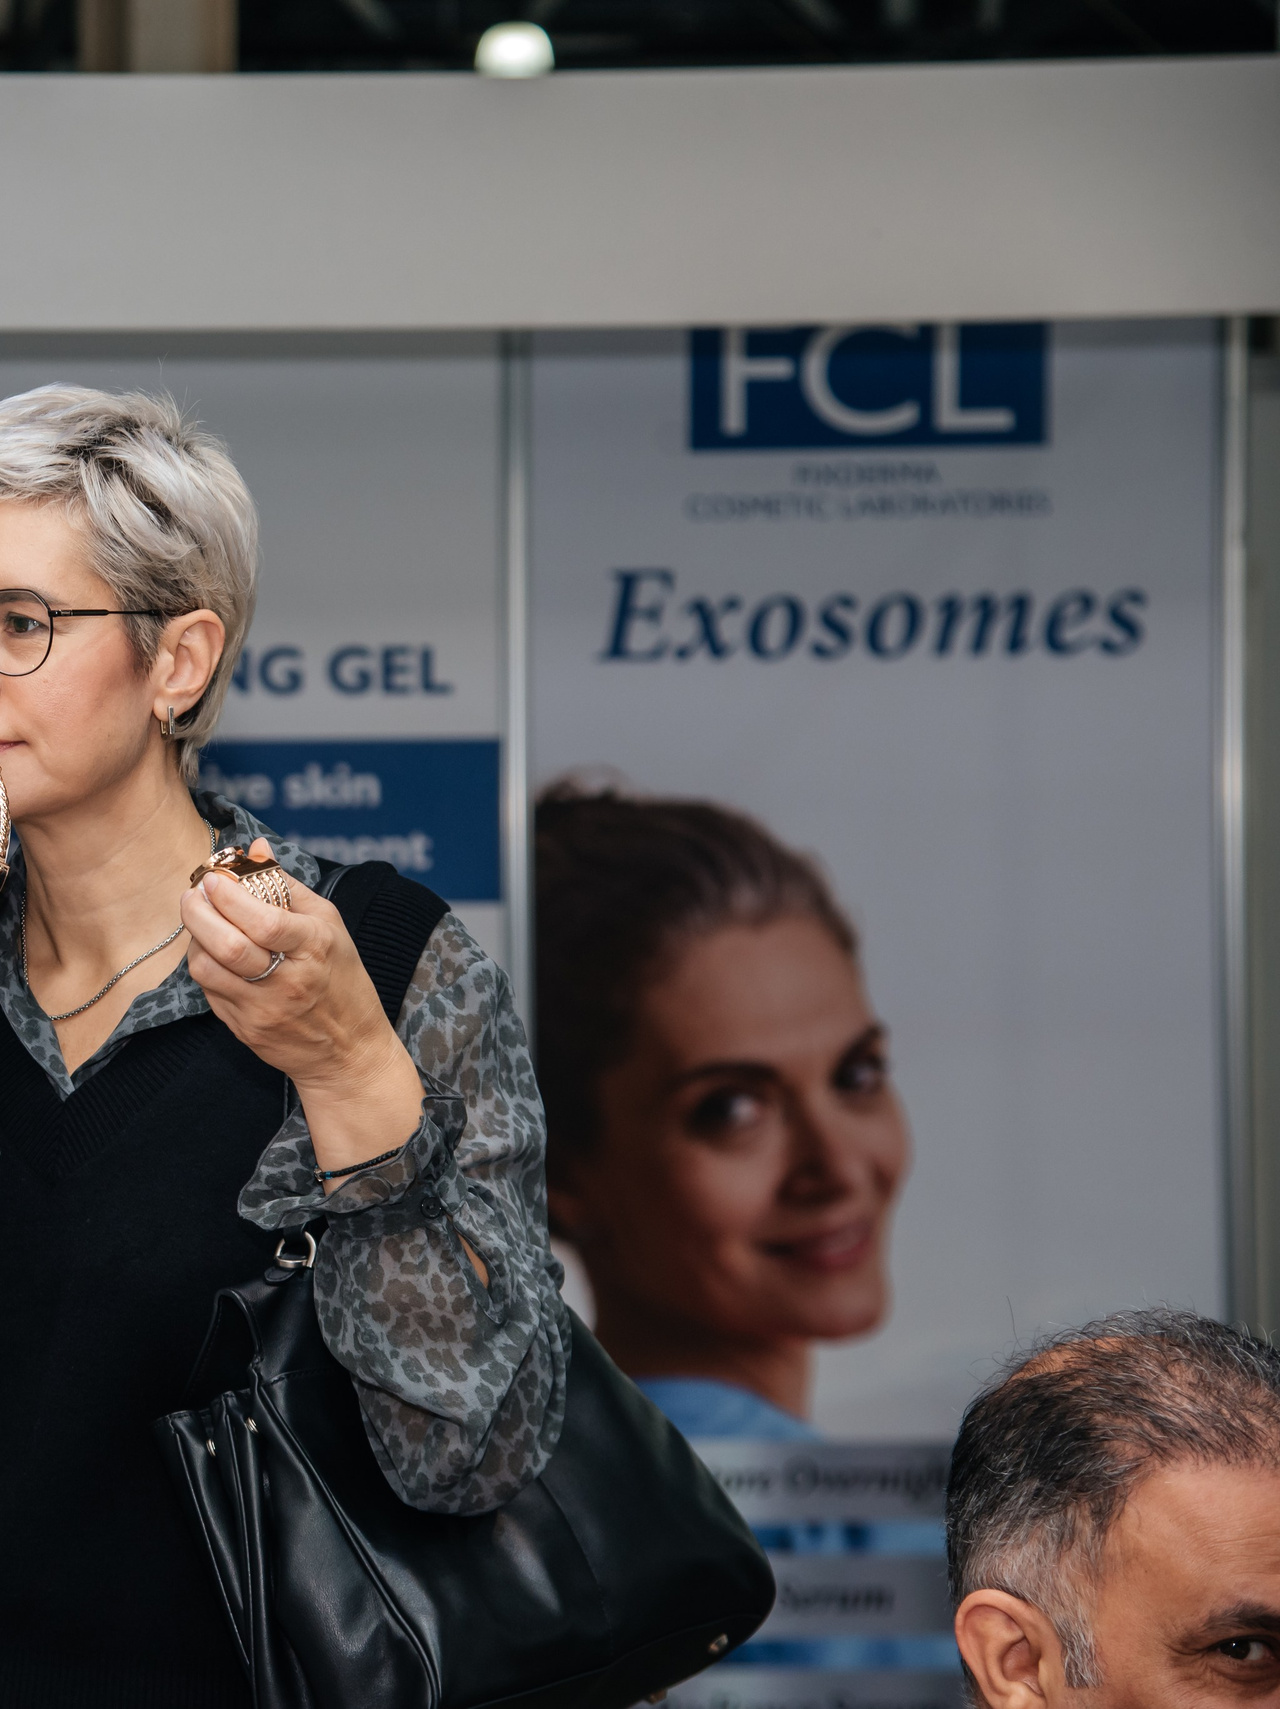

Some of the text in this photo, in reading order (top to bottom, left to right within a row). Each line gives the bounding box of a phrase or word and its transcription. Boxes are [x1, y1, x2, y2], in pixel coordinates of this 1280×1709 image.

[721, 323, 1017, 437] FCL
[599, 567, 1150, 663] Exosomes
[326, 645, 456, 696] GEL
[284, 762, 380, 807] skin
